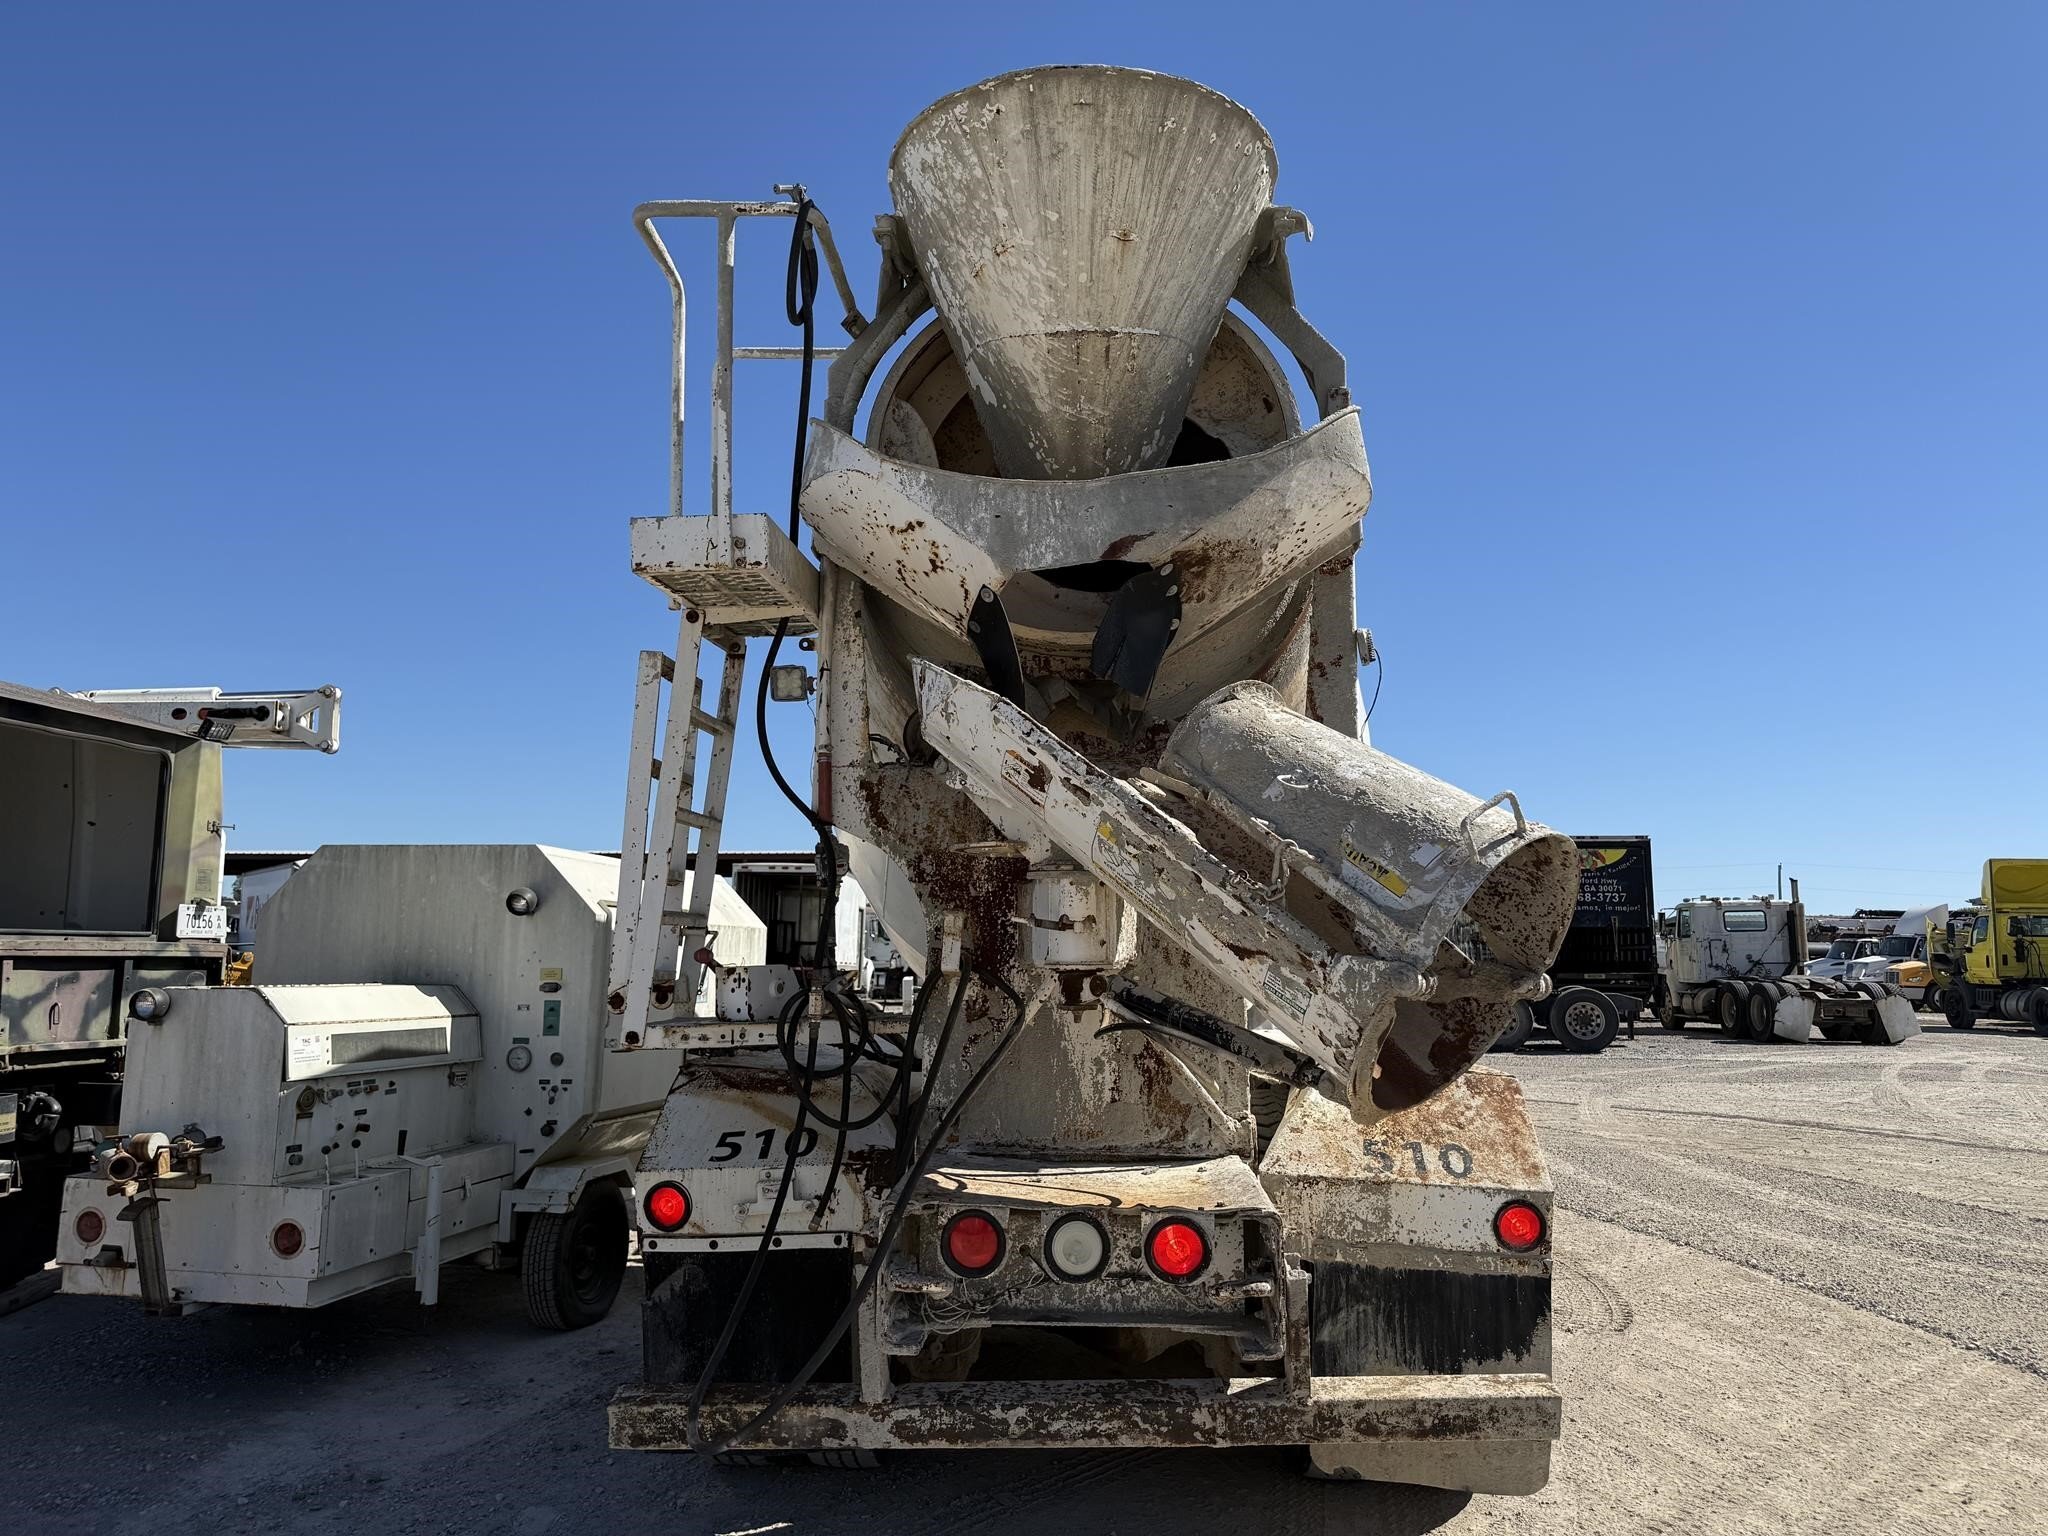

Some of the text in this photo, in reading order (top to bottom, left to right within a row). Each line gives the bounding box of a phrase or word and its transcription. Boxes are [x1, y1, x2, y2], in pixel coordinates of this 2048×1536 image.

[1583, 884, 1622, 892] GA 30071
[1577, 892, 1627, 902] 68-3737
[185, 913, 213, 929] 70156
[708, 1127, 819, 1162] 510
[1362, 1138, 1474, 1179] 510
